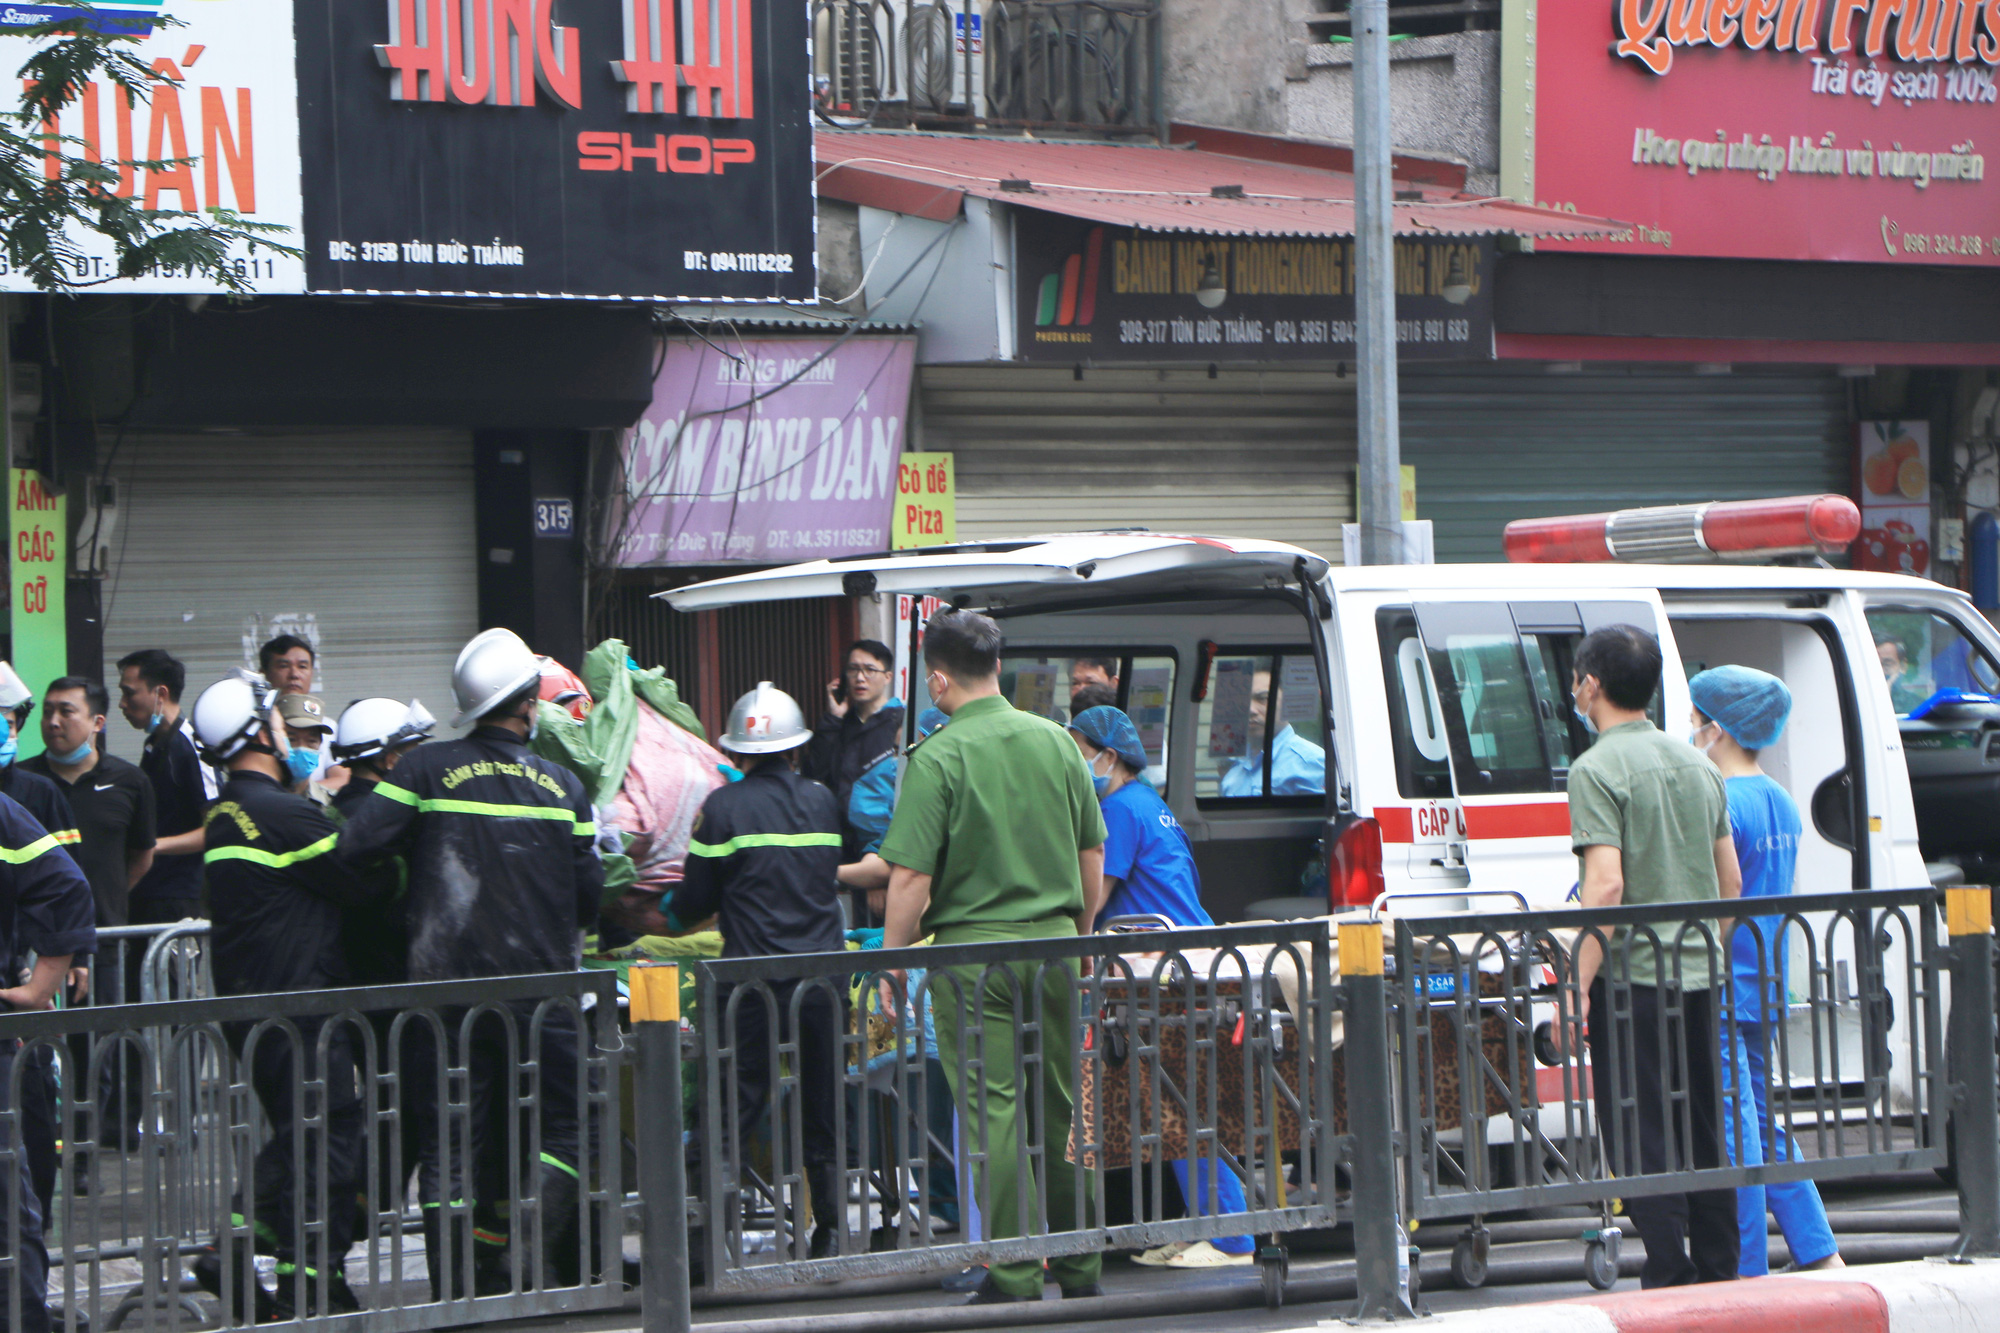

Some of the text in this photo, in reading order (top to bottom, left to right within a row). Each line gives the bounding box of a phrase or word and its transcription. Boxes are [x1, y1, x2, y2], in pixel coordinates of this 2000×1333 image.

[1851, 61, 1889, 107] cây
[1943, 66, 1998, 103] 100%
[577, 131, 755, 175] SHOP
[1632, 128, 1680, 166] Hoa
[1727, 133, 1786, 181] nhập
[1846, 140, 1874, 177] và
[361, 242, 398, 262] 315B
[401, 239, 433, 263] TÔN
[1234, 240, 1342, 295] HONGKONG
[1120, 319, 1168, 343] 309-317
[1170, 315, 1195, 343] TÔN
[1274, 319, 1296, 343] 024
[1424, 319, 1445, 342] 991
[809, 388, 899, 501] DÂN
[898, 463, 921, 495] Có
[537, 504, 569, 531] 315
[906, 504, 944, 536] Piza
[18, 524, 56, 563] CÁC
[23, 575, 48, 614] CỠ
